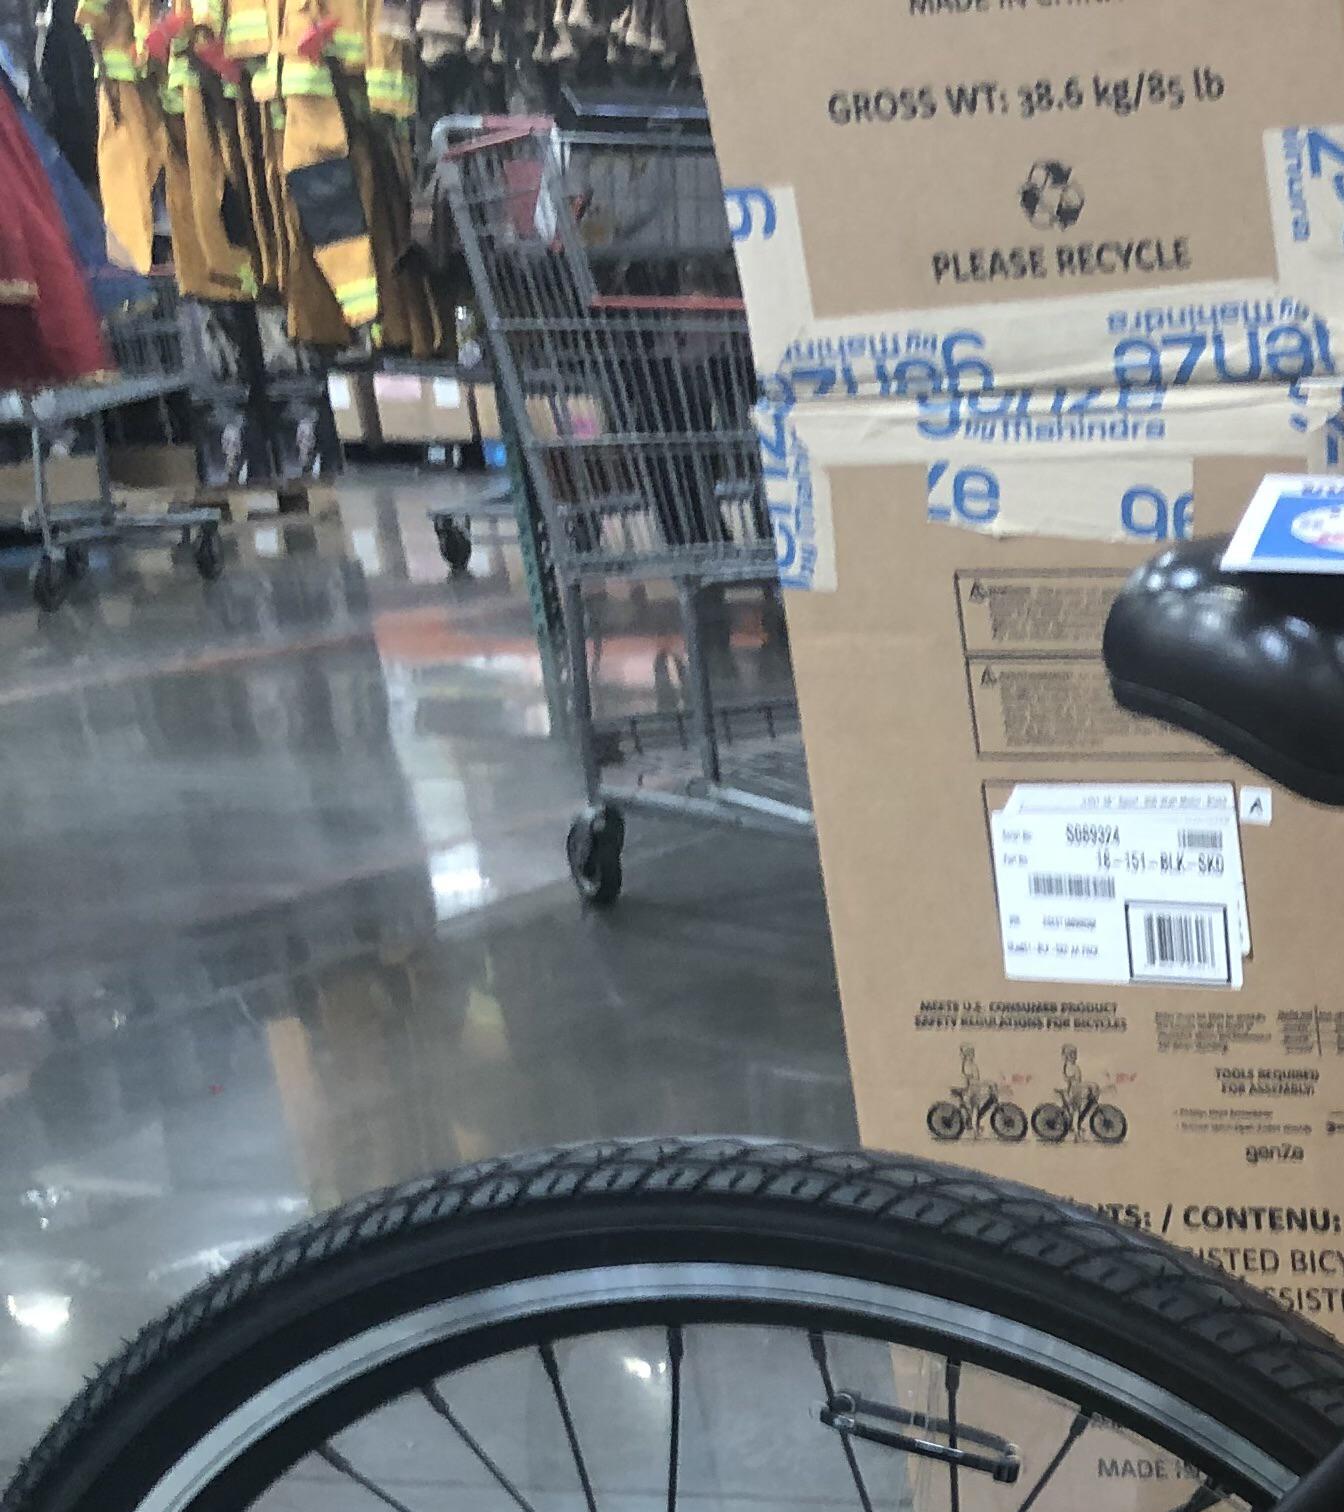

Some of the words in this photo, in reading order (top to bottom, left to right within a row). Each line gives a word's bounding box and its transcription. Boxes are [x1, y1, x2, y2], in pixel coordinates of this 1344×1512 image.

[826, 85, 938, 126] GROSS
[944, 79, 1009, 118] WT:
[1017, 73, 1085, 119] 38.6
[1091, 68, 1186, 117] kg/85
[1192, 64, 1226, 103] lb
[931, 243, 1049, 286] PLEASE
[1055, 234, 1193, 277] RECYCLE
[1215, 1067, 1255, 1080] TOOLS
[1182, 1204, 1342, 1234] CONTENU:
[1098, 1458, 1169, 1480] MADE
